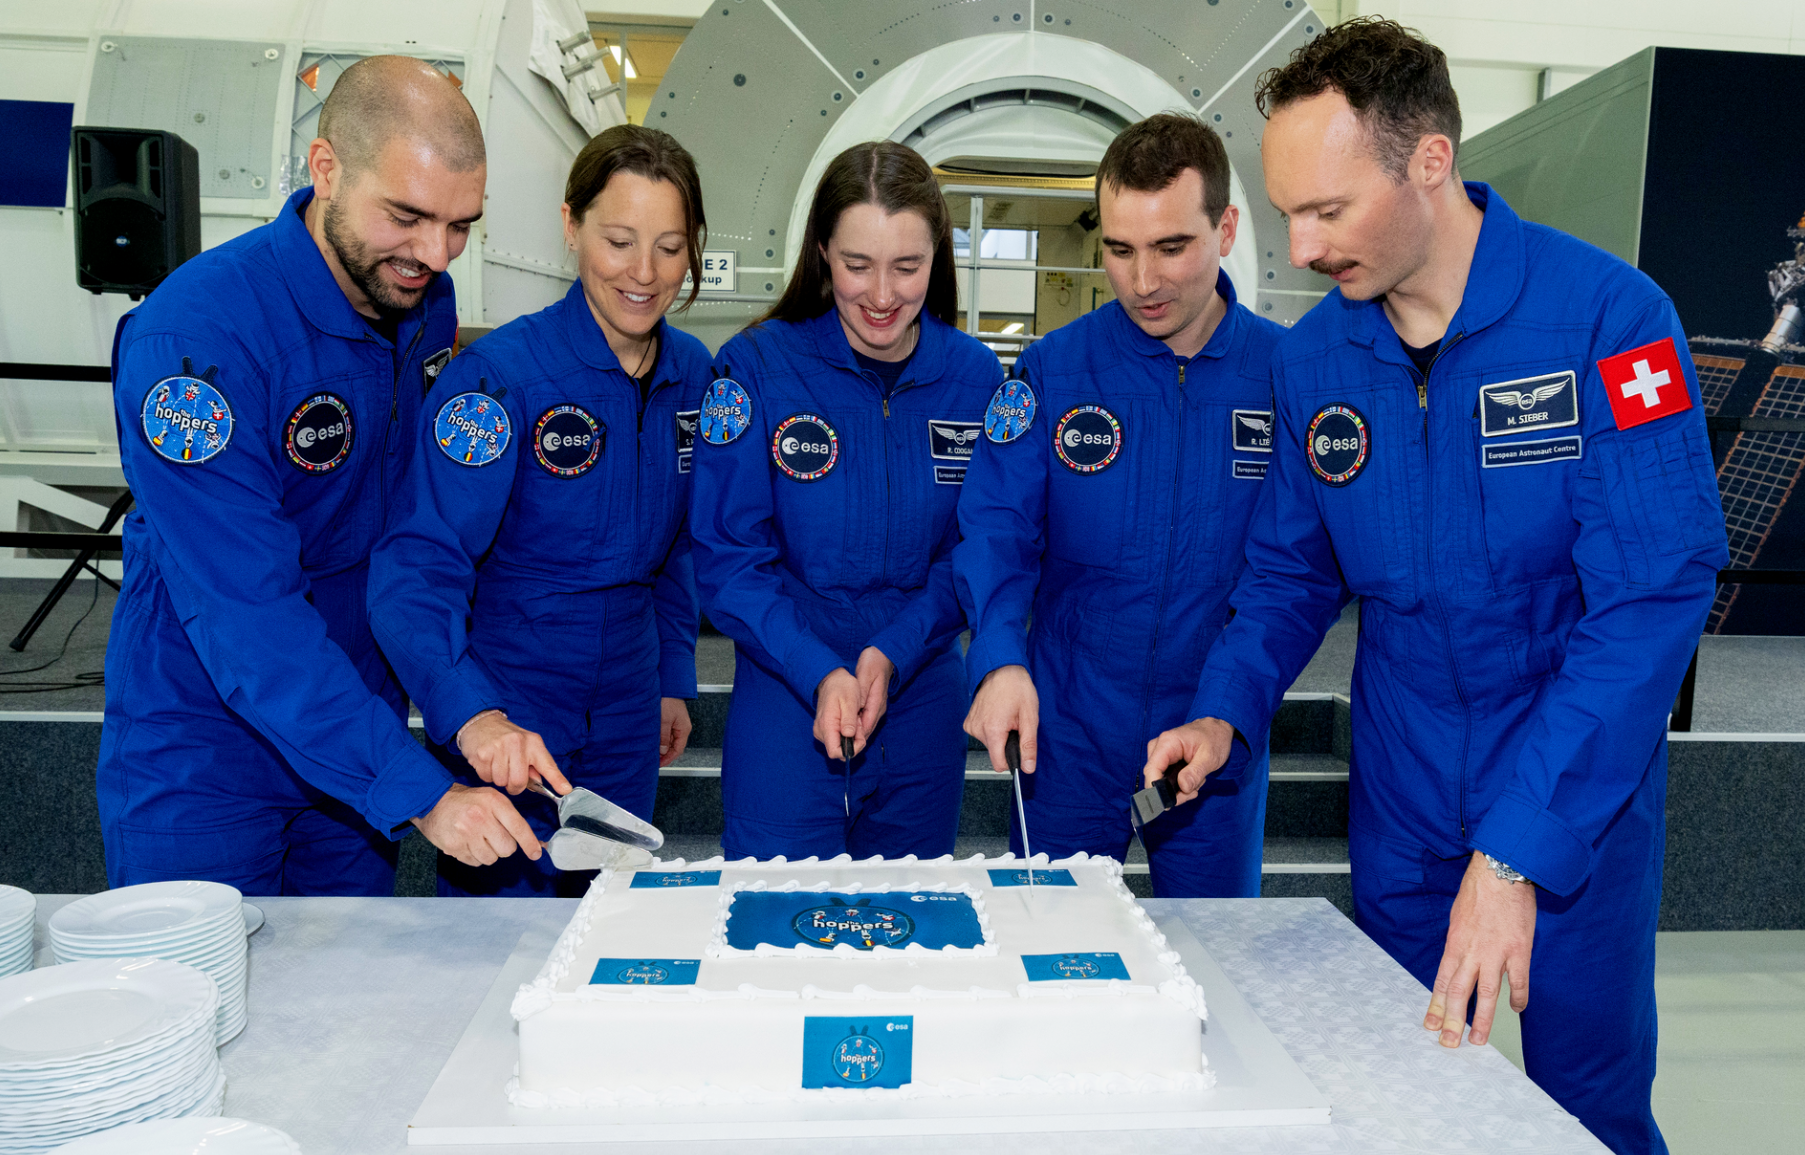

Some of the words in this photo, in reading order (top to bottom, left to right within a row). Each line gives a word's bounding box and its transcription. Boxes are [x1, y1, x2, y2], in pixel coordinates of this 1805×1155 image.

[719, 259, 728, 270] 2
[683, 275, 722, 286] okup
[155, 402, 218, 434] hoppers
[705, 405, 741, 420] hoppers
[991, 404, 1026, 420] hoppers
[1507, 416, 1517, 426] M.
[1518, 411, 1549, 425] SIEBER
[317, 422, 344, 440] esa
[447, 410, 498, 444] hoppers
[562, 434, 592, 447] esa
[1083, 433, 1112, 446] esa
[1332, 437, 1359, 451] esa
[801, 442, 829, 455] esa
[1488, 451, 1518, 460] European
[1519, 447, 1553, 458] Astronaut
[1553, 444, 1577, 453] Centre
[813, 919, 894, 932] hoppers
[840, 1054, 876, 1065] hoppers
